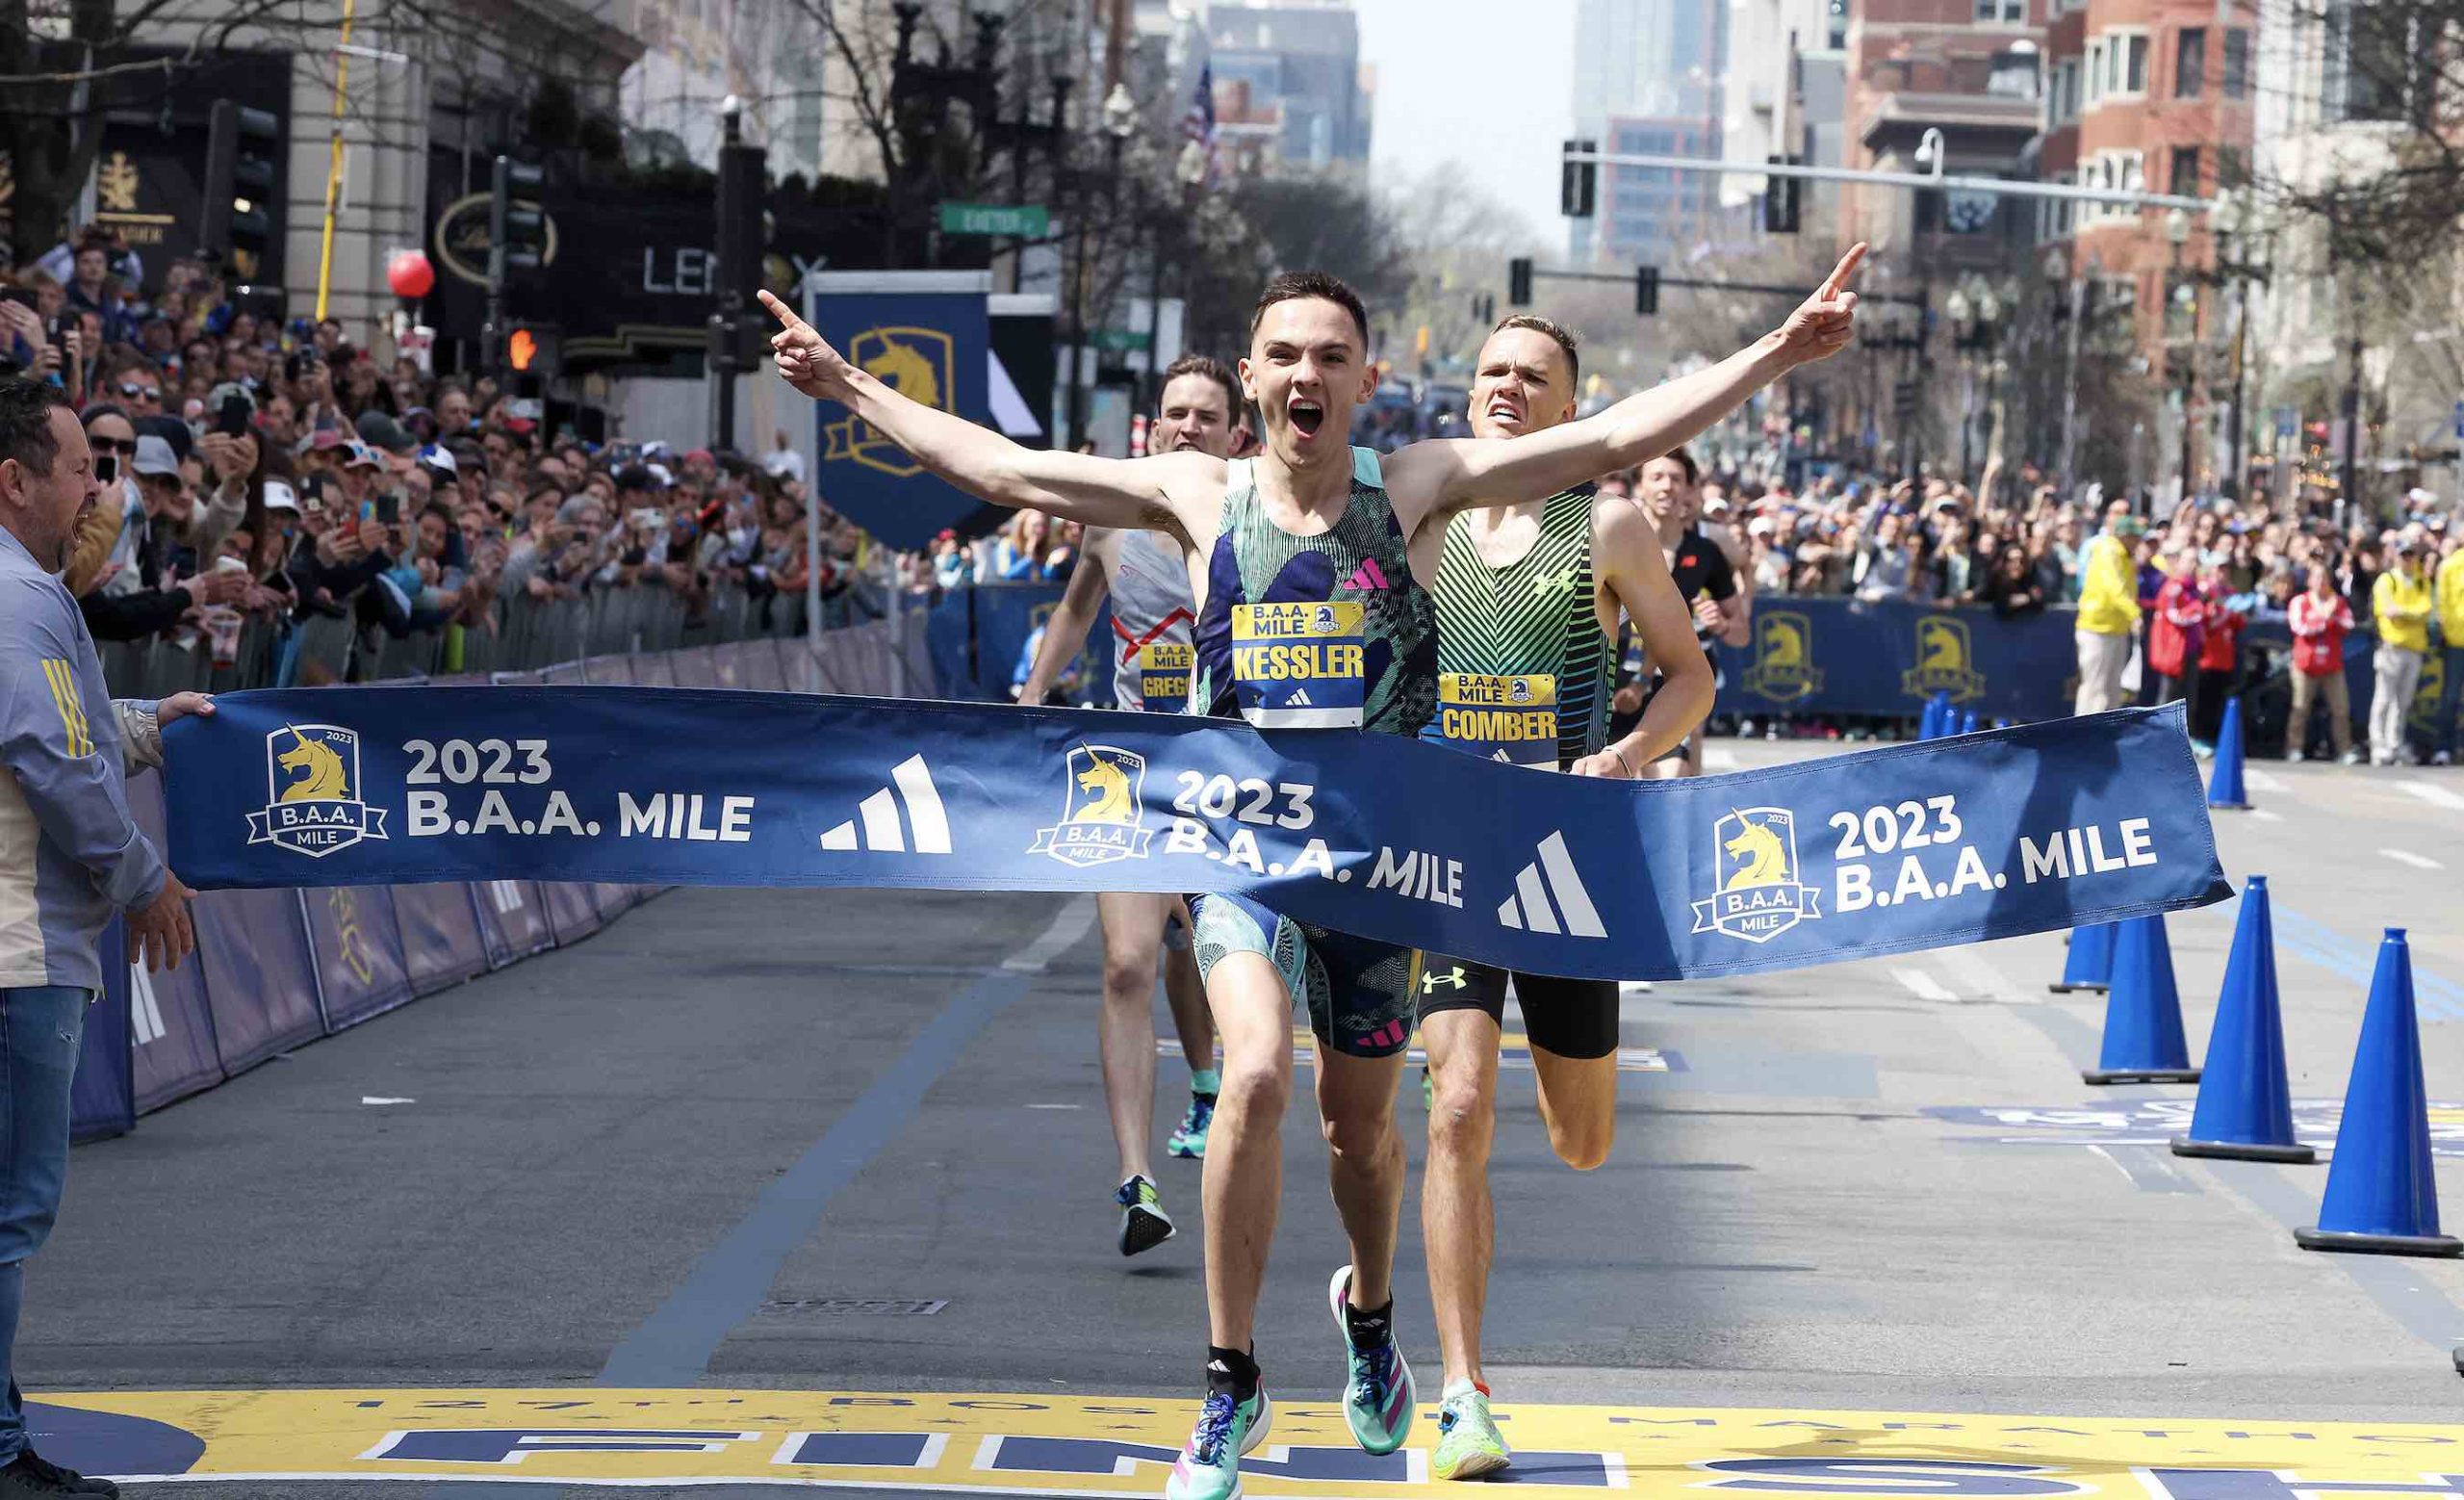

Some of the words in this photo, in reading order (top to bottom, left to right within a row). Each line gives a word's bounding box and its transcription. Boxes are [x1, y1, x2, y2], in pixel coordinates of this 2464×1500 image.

[1254, 605, 1308, 618] B.A.A.
[1254, 619, 1304, 635] MILE
[1154, 646, 1191, 656] B.A.A.
[1155, 657, 1189, 667] MILE
[1233, 644, 1364, 681] KESSLER
[1142, 677, 1191, 697] GREG
[1458, 675, 1506, 688] B.A.A.
[1458, 688, 1503, 702] MILE
[1443, 709, 1557, 740] COMBER
[326, 731, 353, 744] 2023
[401, 739, 552, 785] 2023
[1116, 754, 1142, 768] 2023
[1171, 770, 1315, 830] 2023
[281, 805, 355, 826] B.A.A.
[407, 789, 601, 837] B.A.A.
[618, 792, 755, 842] MILE
[1767, 813, 1789, 826] 2023
[1065, 826, 1126, 845] B.A.A.
[1829, 794, 1963, 861] 2023
[296, 831, 338, 845] MILE
[1068, 846, 1108, 859] MILE
[1163, 816, 1351, 884] B.A.A.
[1366, 846, 1464, 909] MILE
[1836, 845, 2007, 914] B.A.A.
[2020, 817, 2158, 885] MILE
[1727, 891, 1793, 913] B.A.A.
[1740, 914, 1781, 932] MILE
